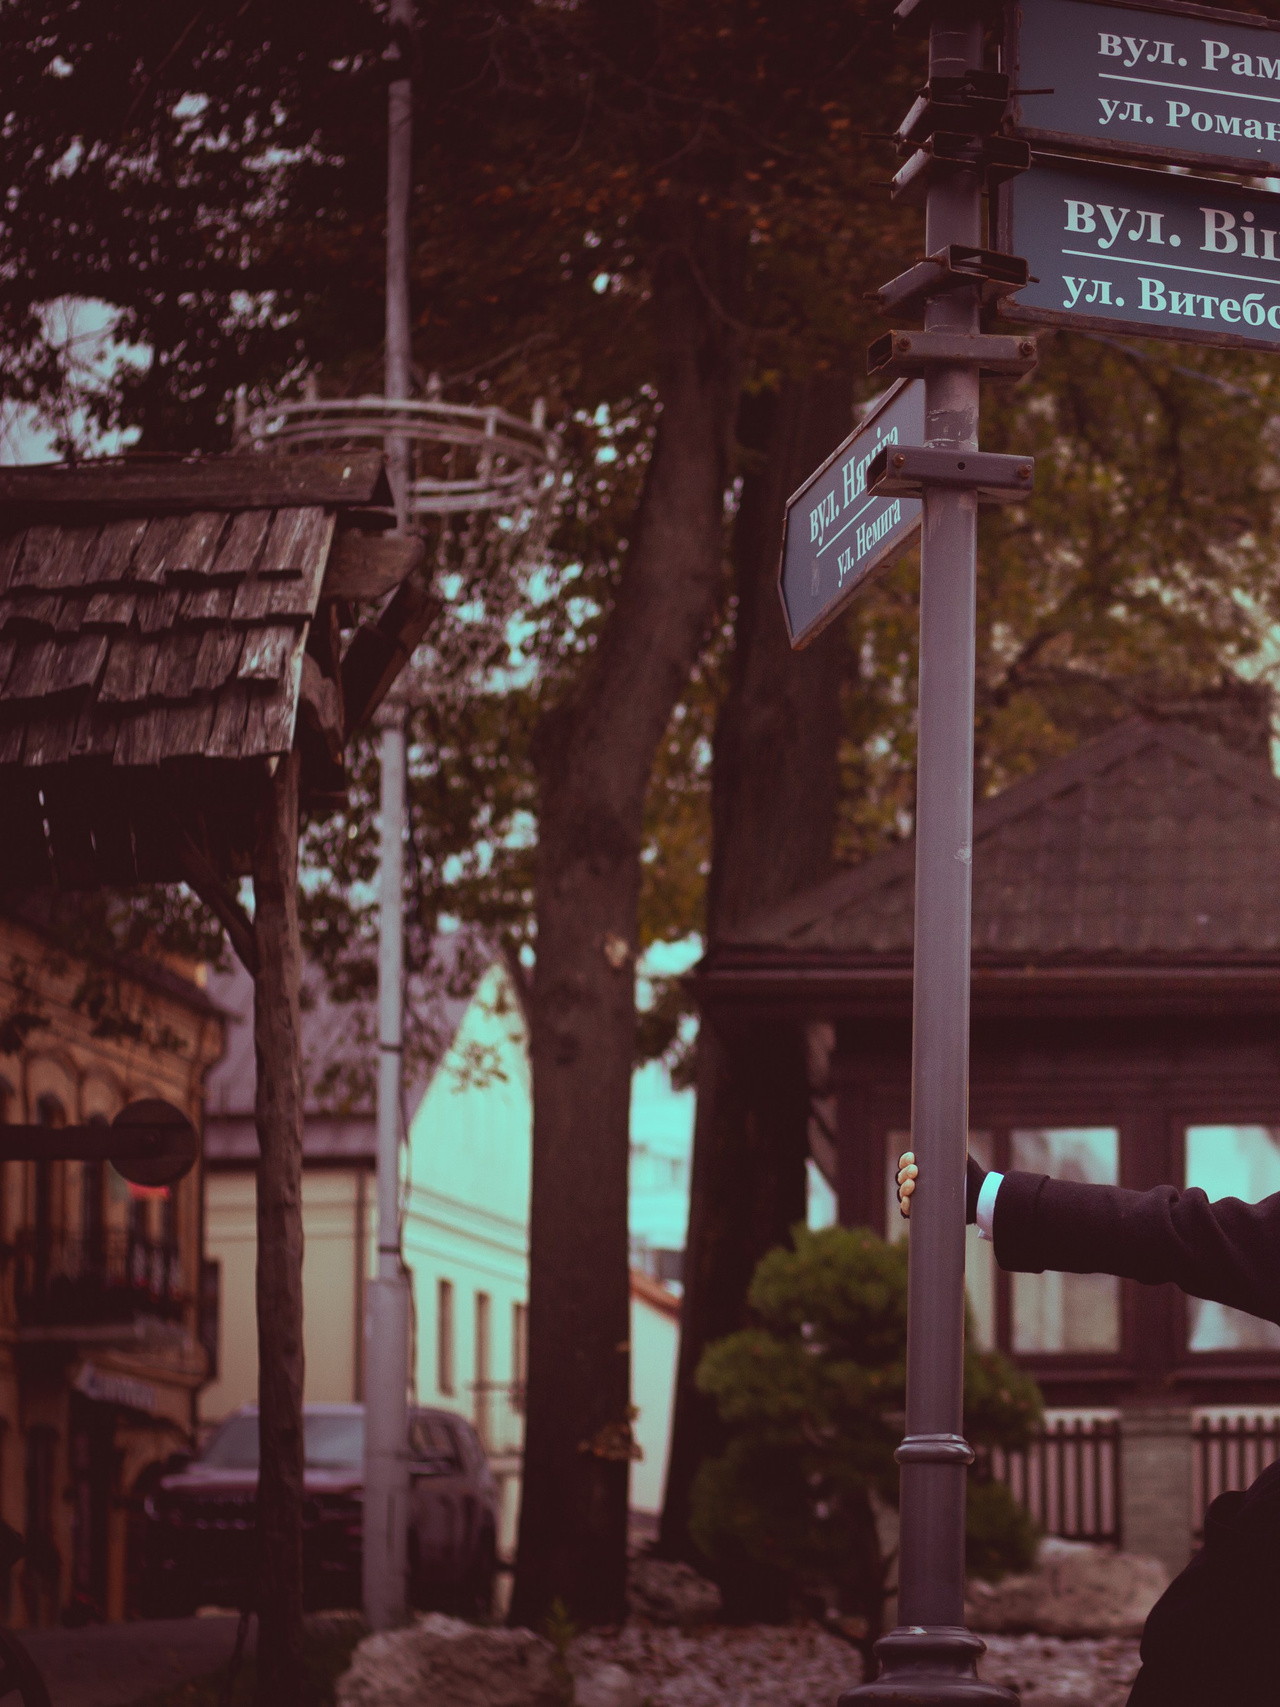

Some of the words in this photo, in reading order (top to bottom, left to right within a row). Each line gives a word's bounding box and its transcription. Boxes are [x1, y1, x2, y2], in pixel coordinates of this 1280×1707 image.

[1097, 32, 1188, 67] вул.
[1097, 97, 1155, 126] ул.
[1063, 198, 1182, 249] вул.
[1062, 275, 1125, 309] ул.
[809, 489, 840, 547] вул.
[837, 546, 855, 588] ул.
[855, 498, 902, 562] Немига
